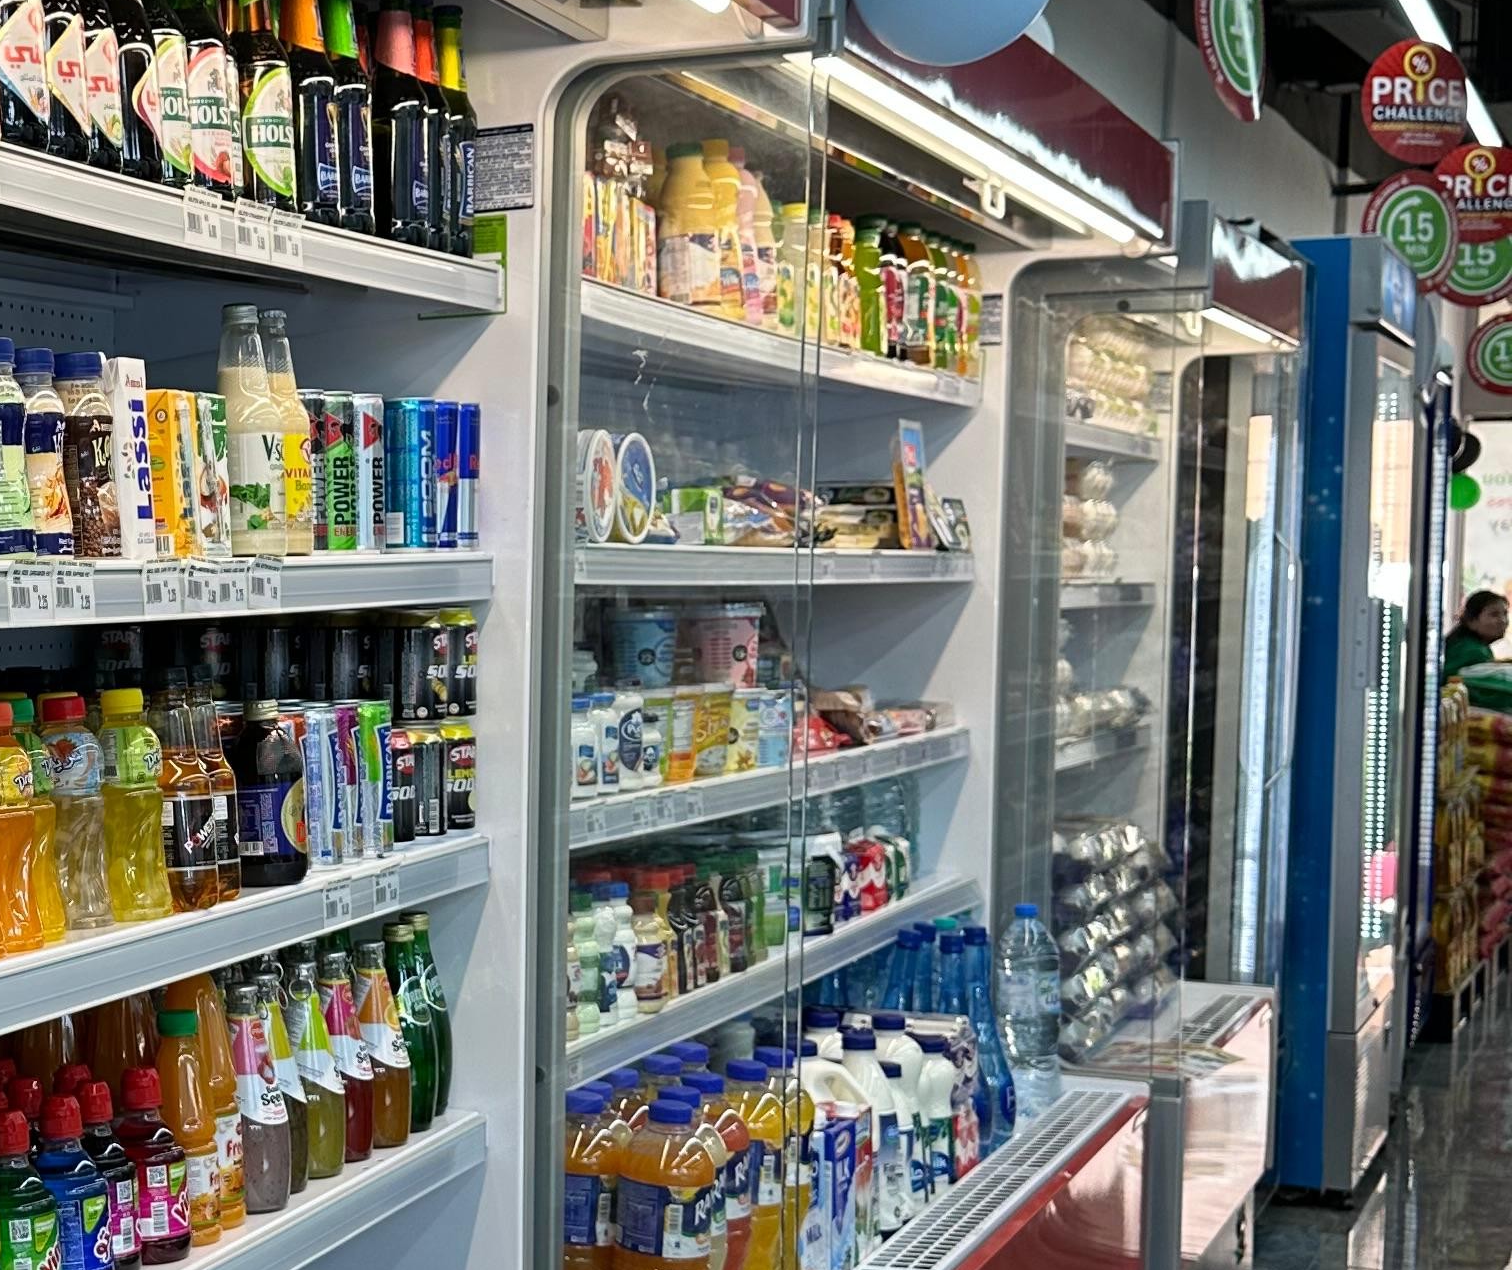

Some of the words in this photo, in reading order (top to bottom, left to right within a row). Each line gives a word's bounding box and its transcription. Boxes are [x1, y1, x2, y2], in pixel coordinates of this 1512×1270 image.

[1373, 104, 1463, 123] CHALLENGE
[1398, 211, 1434, 243] 15
[128, 399, 154, 520] Lassi
[333, 456, 350, 525] POWER
[372, 456, 384, 525] POWER
